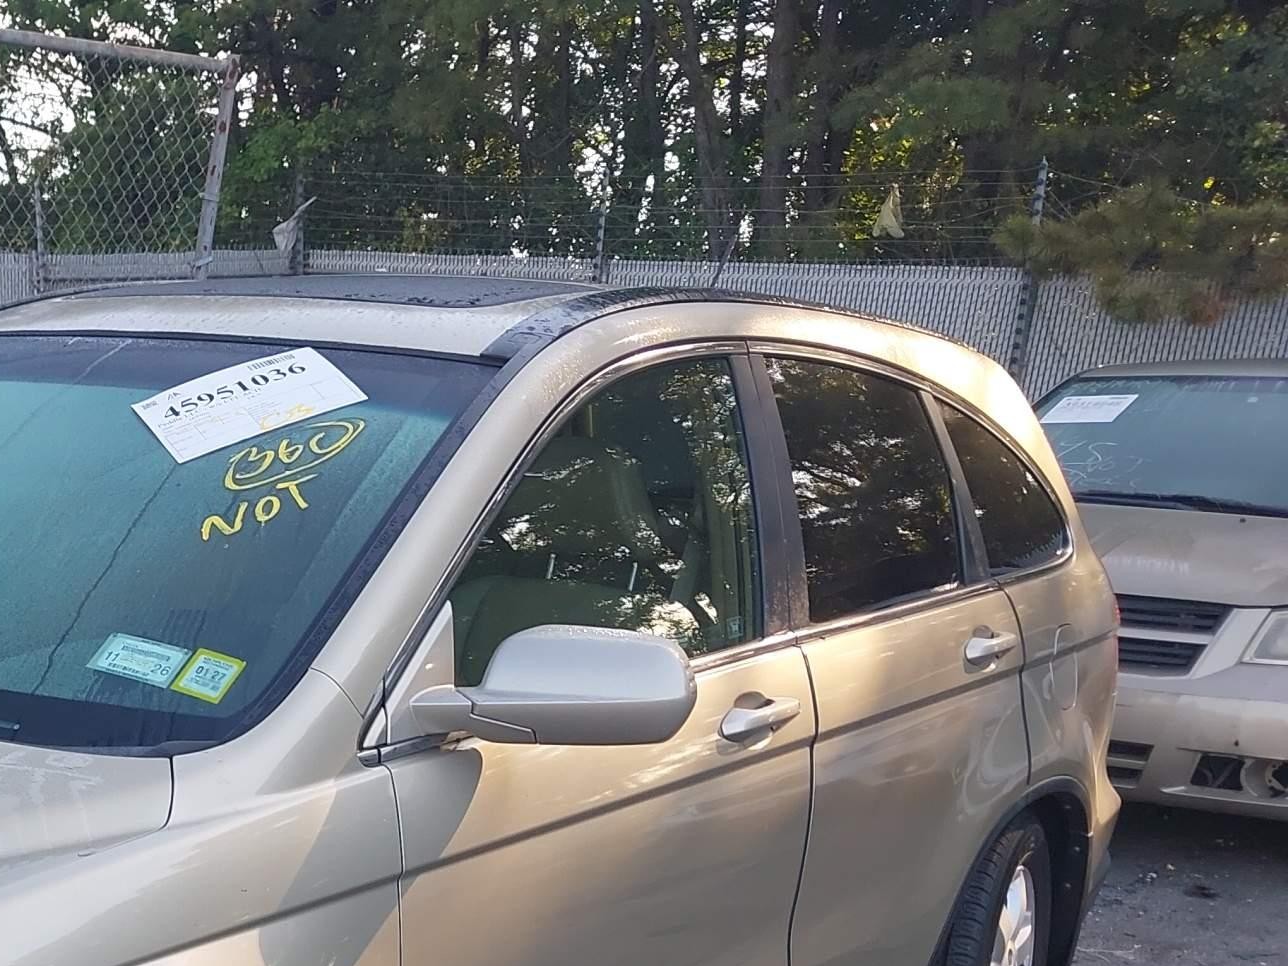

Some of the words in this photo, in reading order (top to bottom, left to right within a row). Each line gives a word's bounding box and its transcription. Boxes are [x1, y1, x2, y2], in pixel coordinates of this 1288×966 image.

[163, 362, 307, 419] 45951036
[200, 473, 319, 541] NOT
[105, 651, 119, 662] 11
[150, 663, 171, 677] 26
